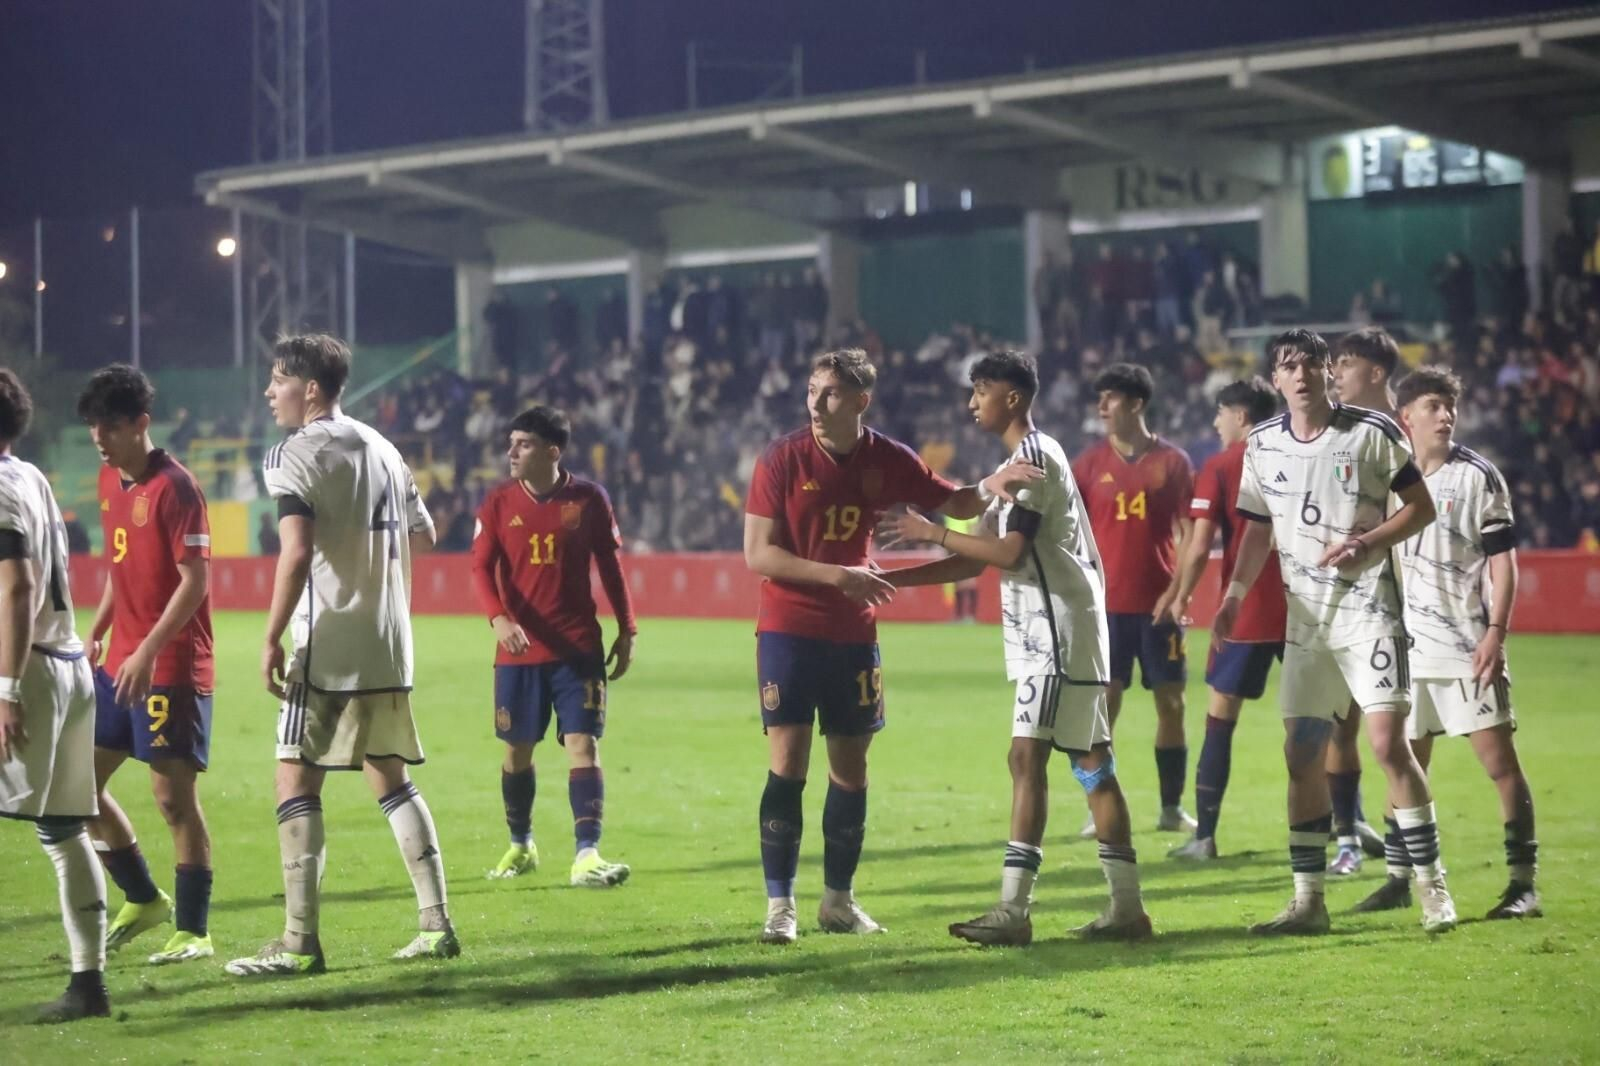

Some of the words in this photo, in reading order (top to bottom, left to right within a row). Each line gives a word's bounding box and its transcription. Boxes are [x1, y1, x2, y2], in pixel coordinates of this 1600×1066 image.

[368, 476, 400, 560] 4
[823, 505, 861, 541] 19
[1116, 490, 1147, 521] 14
[1301, 491, 1321, 526] 6
[113, 527, 127, 563] 9
[529, 533, 556, 564] 11
[1370, 638, 1392, 671] 6
[147, 694, 170, 731] 9
